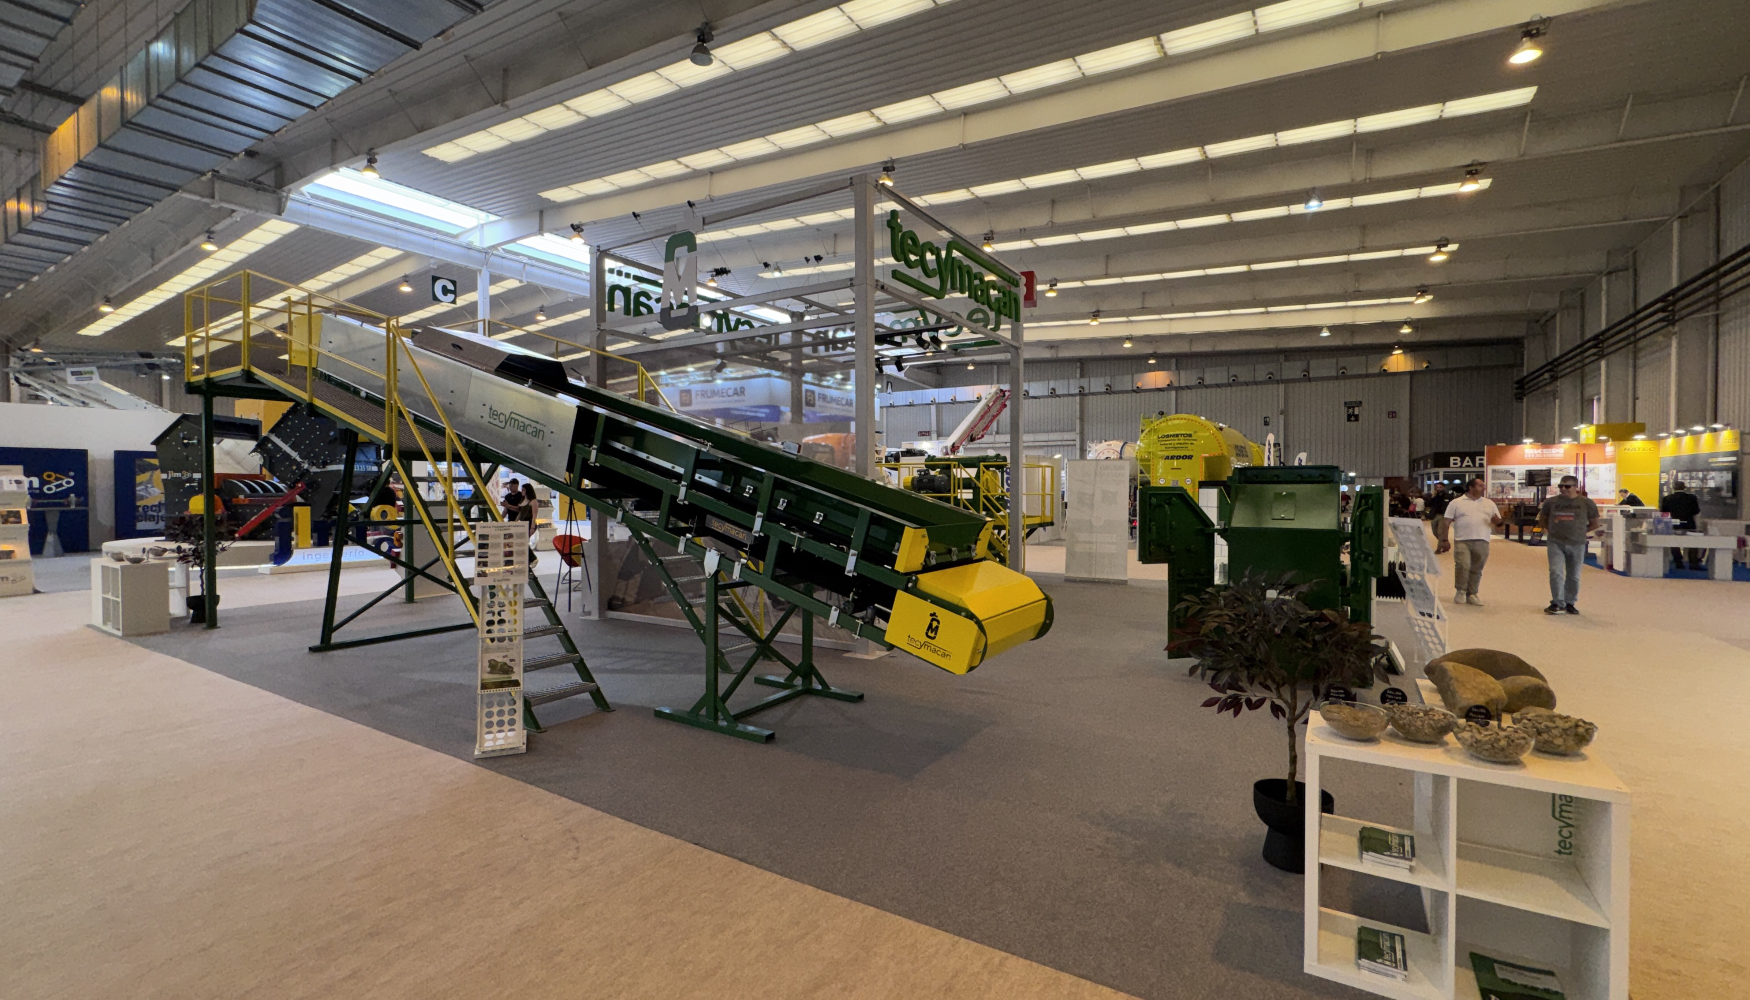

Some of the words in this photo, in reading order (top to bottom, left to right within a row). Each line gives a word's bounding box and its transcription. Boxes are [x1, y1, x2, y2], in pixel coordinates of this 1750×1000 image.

[887, 209, 1020, 322] tecymacan
[434, 278, 455, 302] C
[695, 386, 745, 399] FRUMECAR
[817, 393, 854, 407] FRUMECAR
[487, 405, 547, 441] tecymacan
[1450, 456, 1485, 467] BAR
[711, 518, 747, 541] tecymacan
[906, 634, 953, 661] tecymacan
